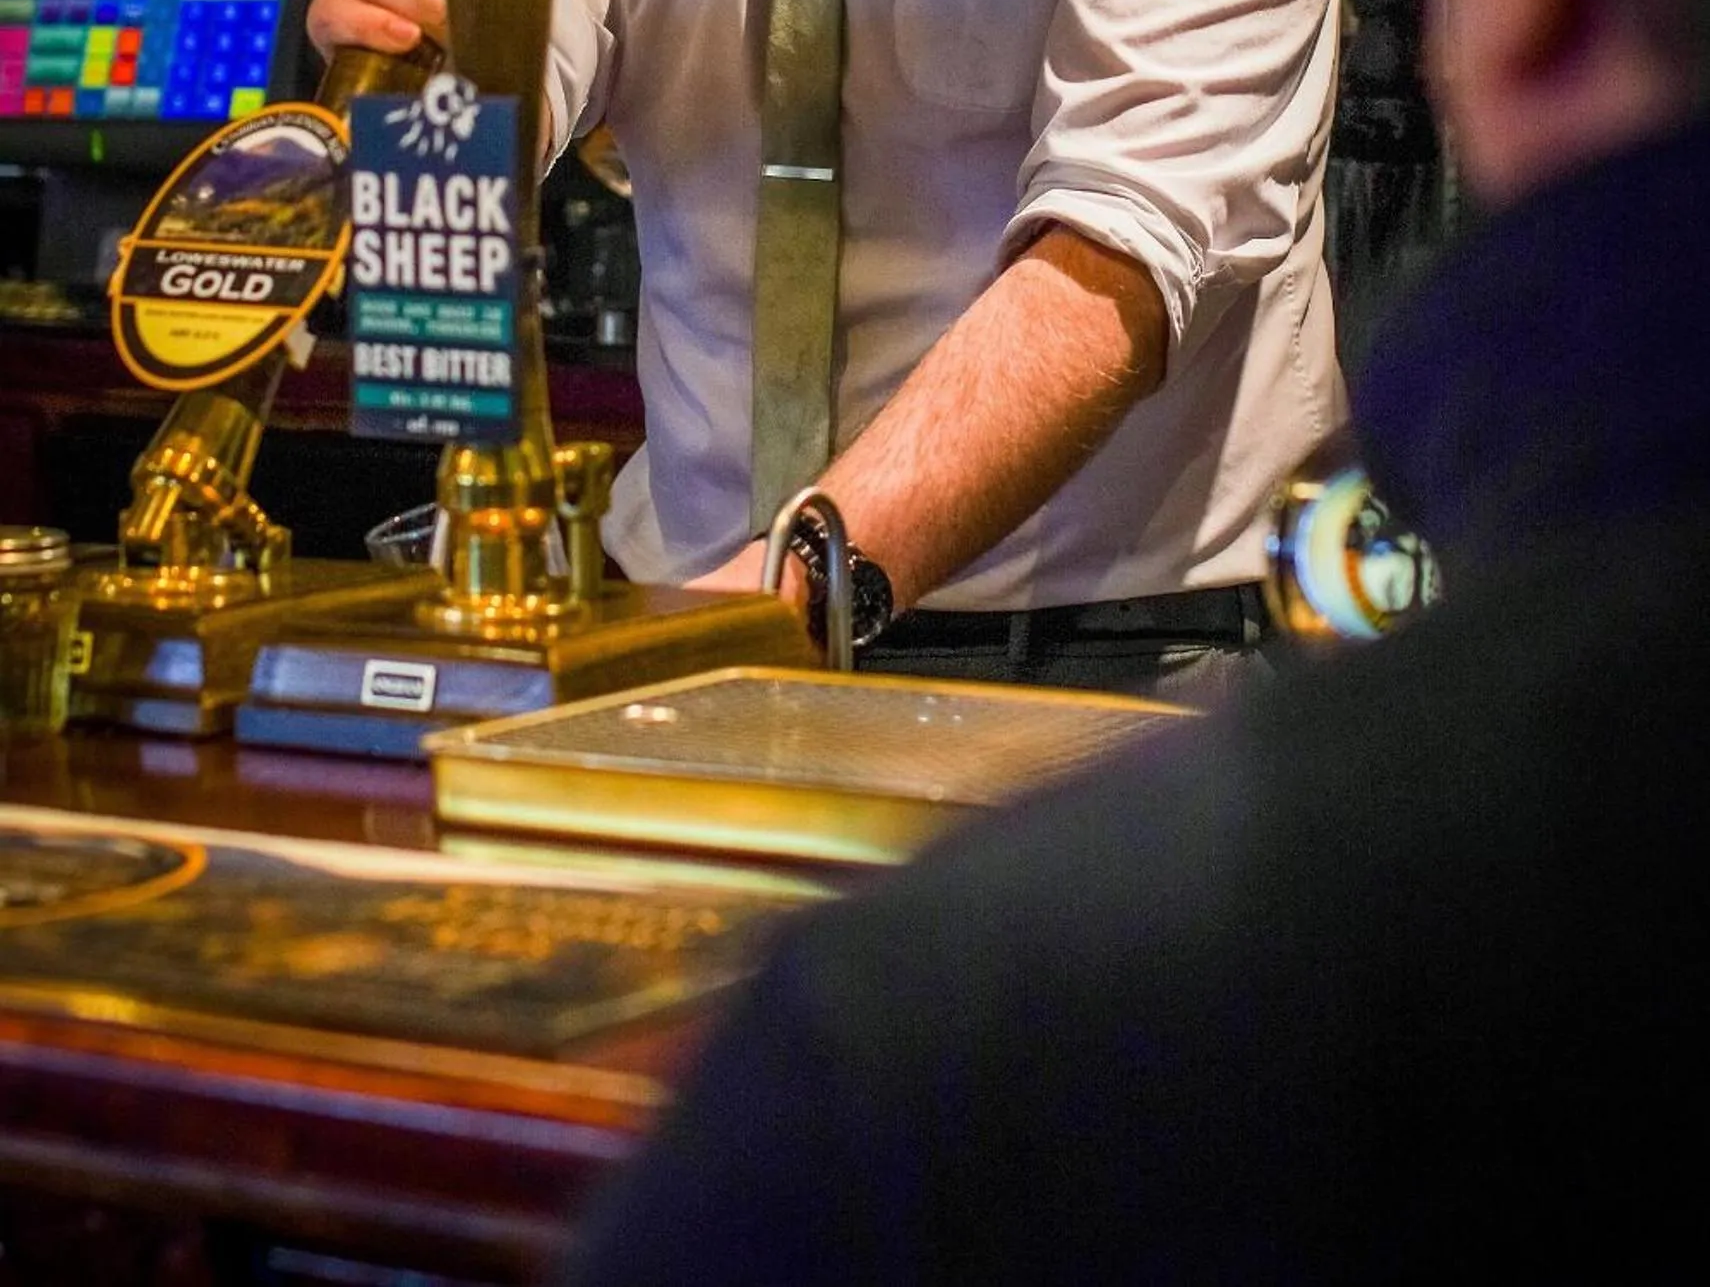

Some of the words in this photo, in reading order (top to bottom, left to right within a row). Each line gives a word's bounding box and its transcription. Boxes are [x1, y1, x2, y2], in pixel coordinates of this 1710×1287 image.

[352, 170, 511, 233] BLACK
[155, 249, 305, 272] LOWESWATER
[160, 264, 274, 301] GOLD
[352, 228, 510, 293] SHEEP
[353, 341, 417, 380] BEST
[421, 345, 512, 389] BITTER
